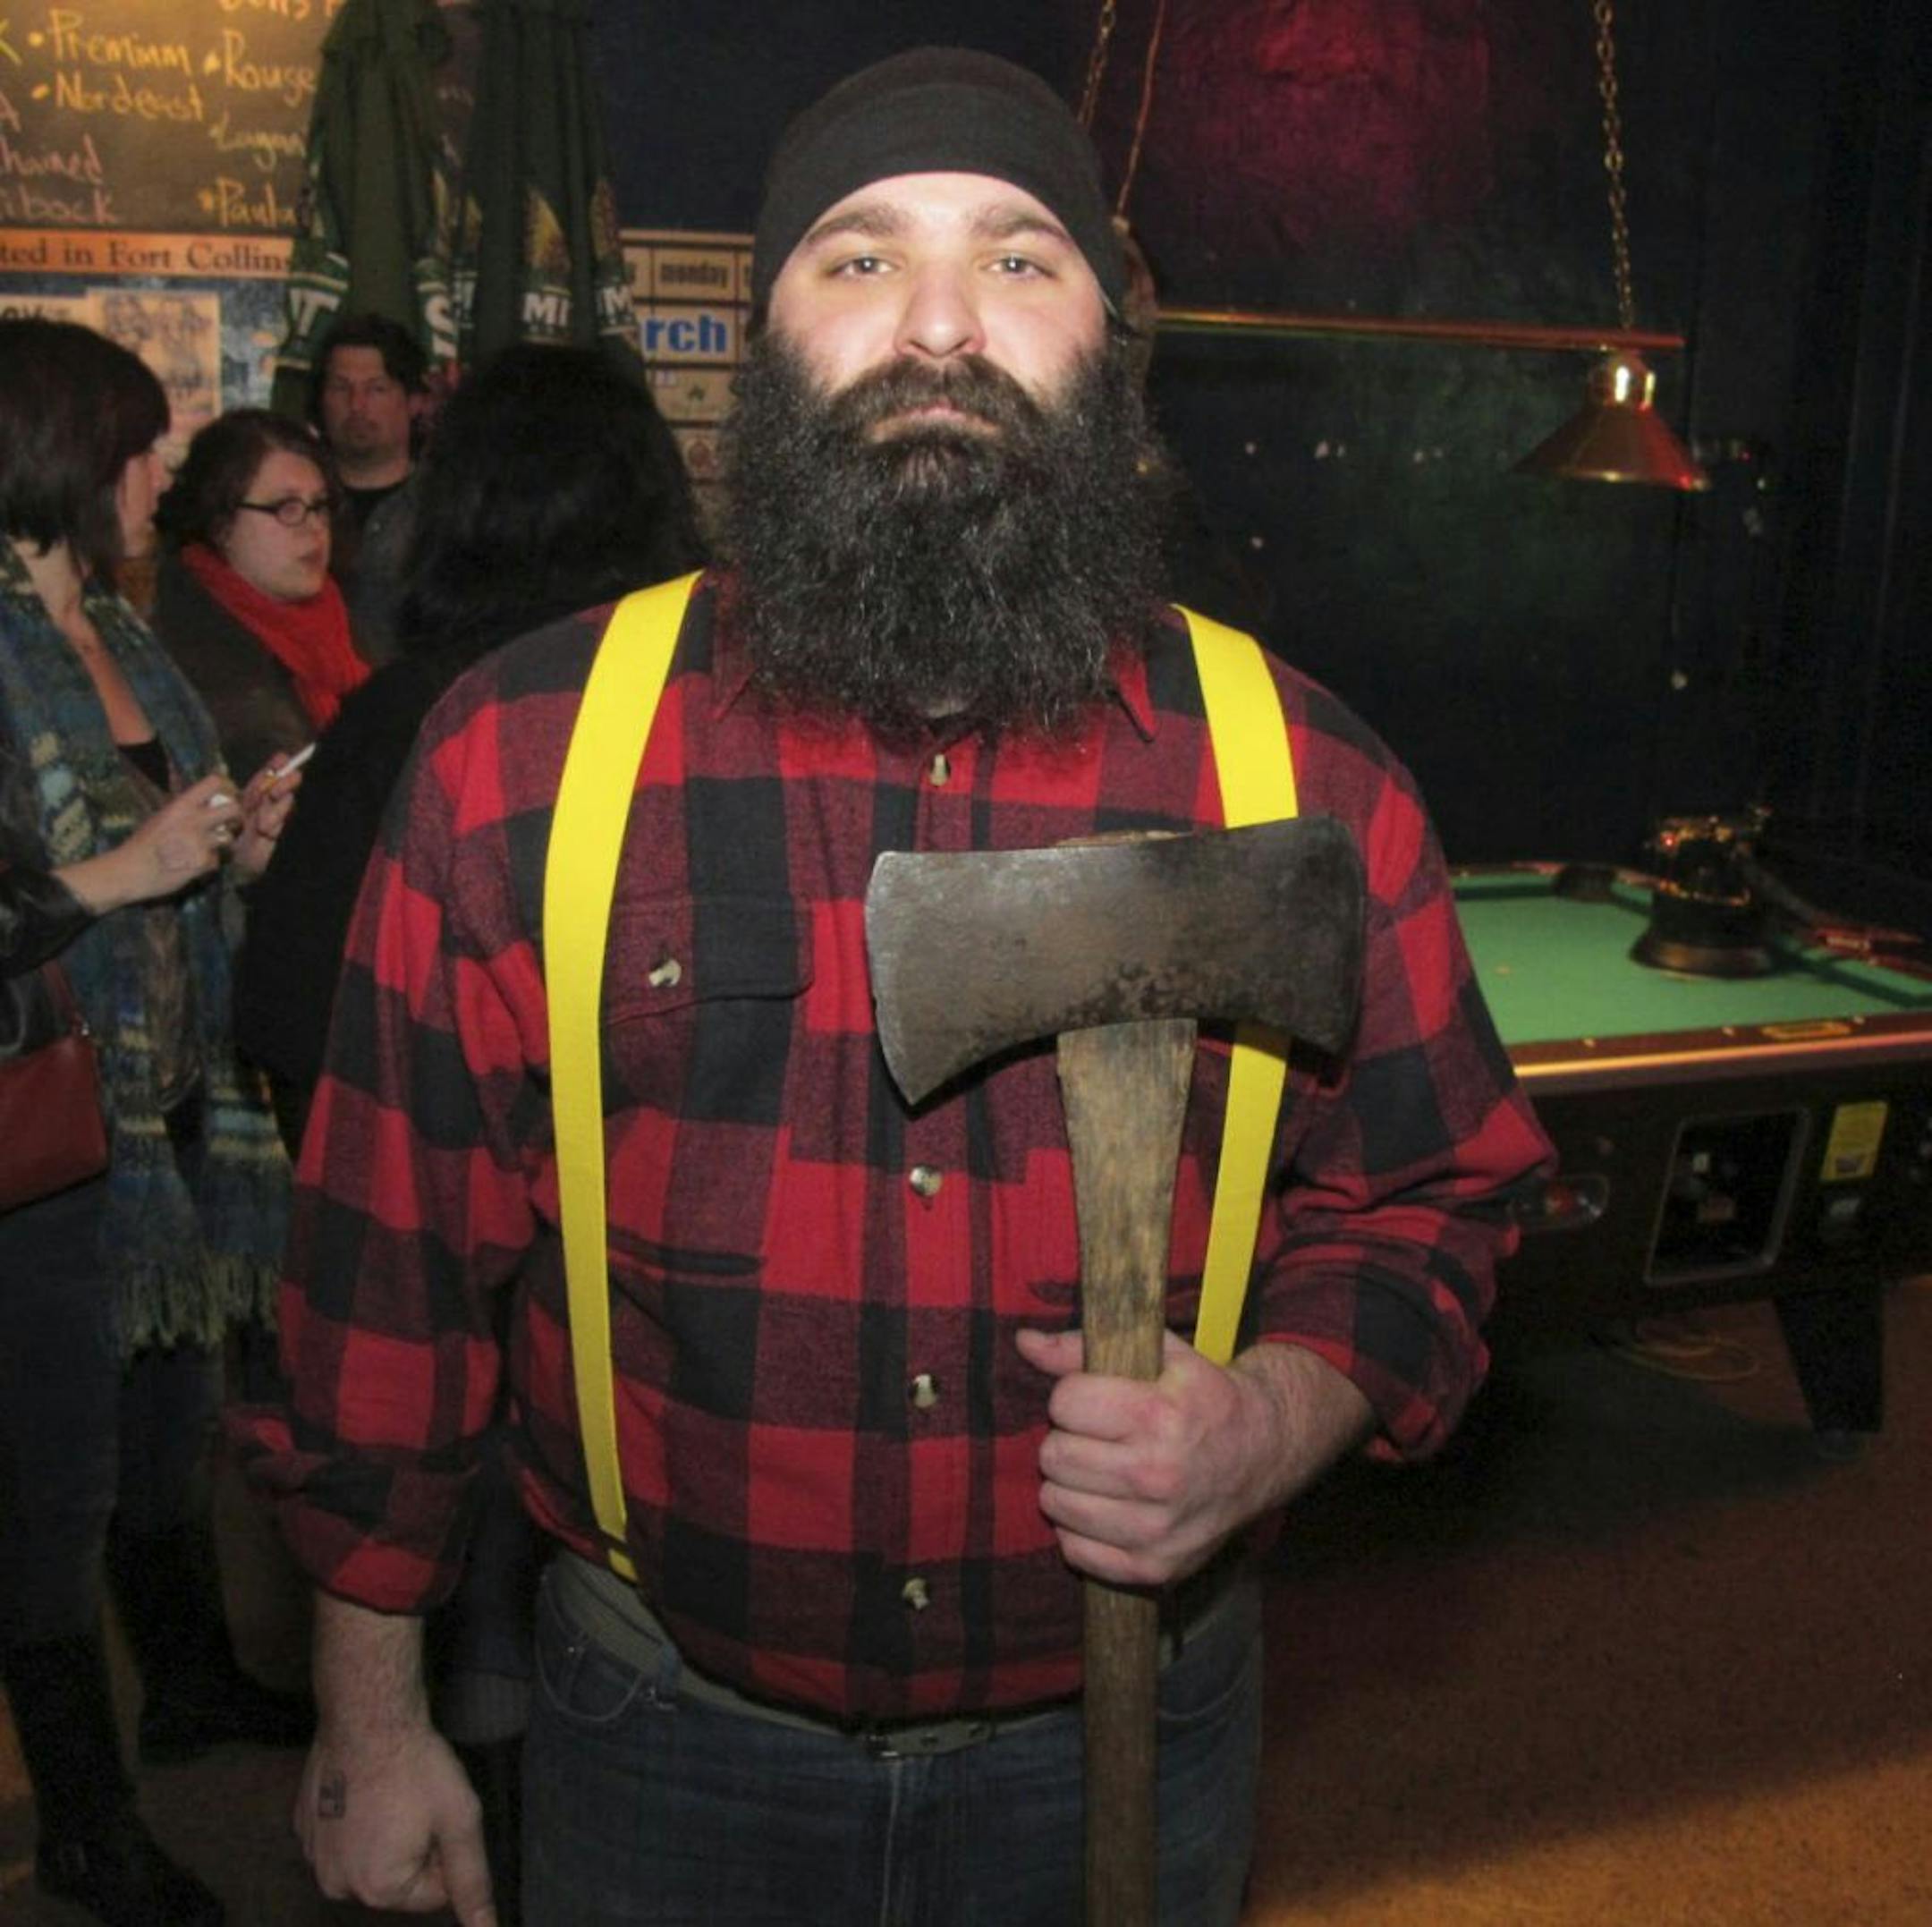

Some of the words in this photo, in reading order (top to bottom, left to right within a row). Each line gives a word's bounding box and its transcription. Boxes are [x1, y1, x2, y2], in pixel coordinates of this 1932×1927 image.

[50, 7, 192, 78] Premium
[224, 30, 317, 108] Rouge
[64, 239, 94, 267] in
[109, 241, 170, 269] Fort
[644, 314, 728, 353] rch
